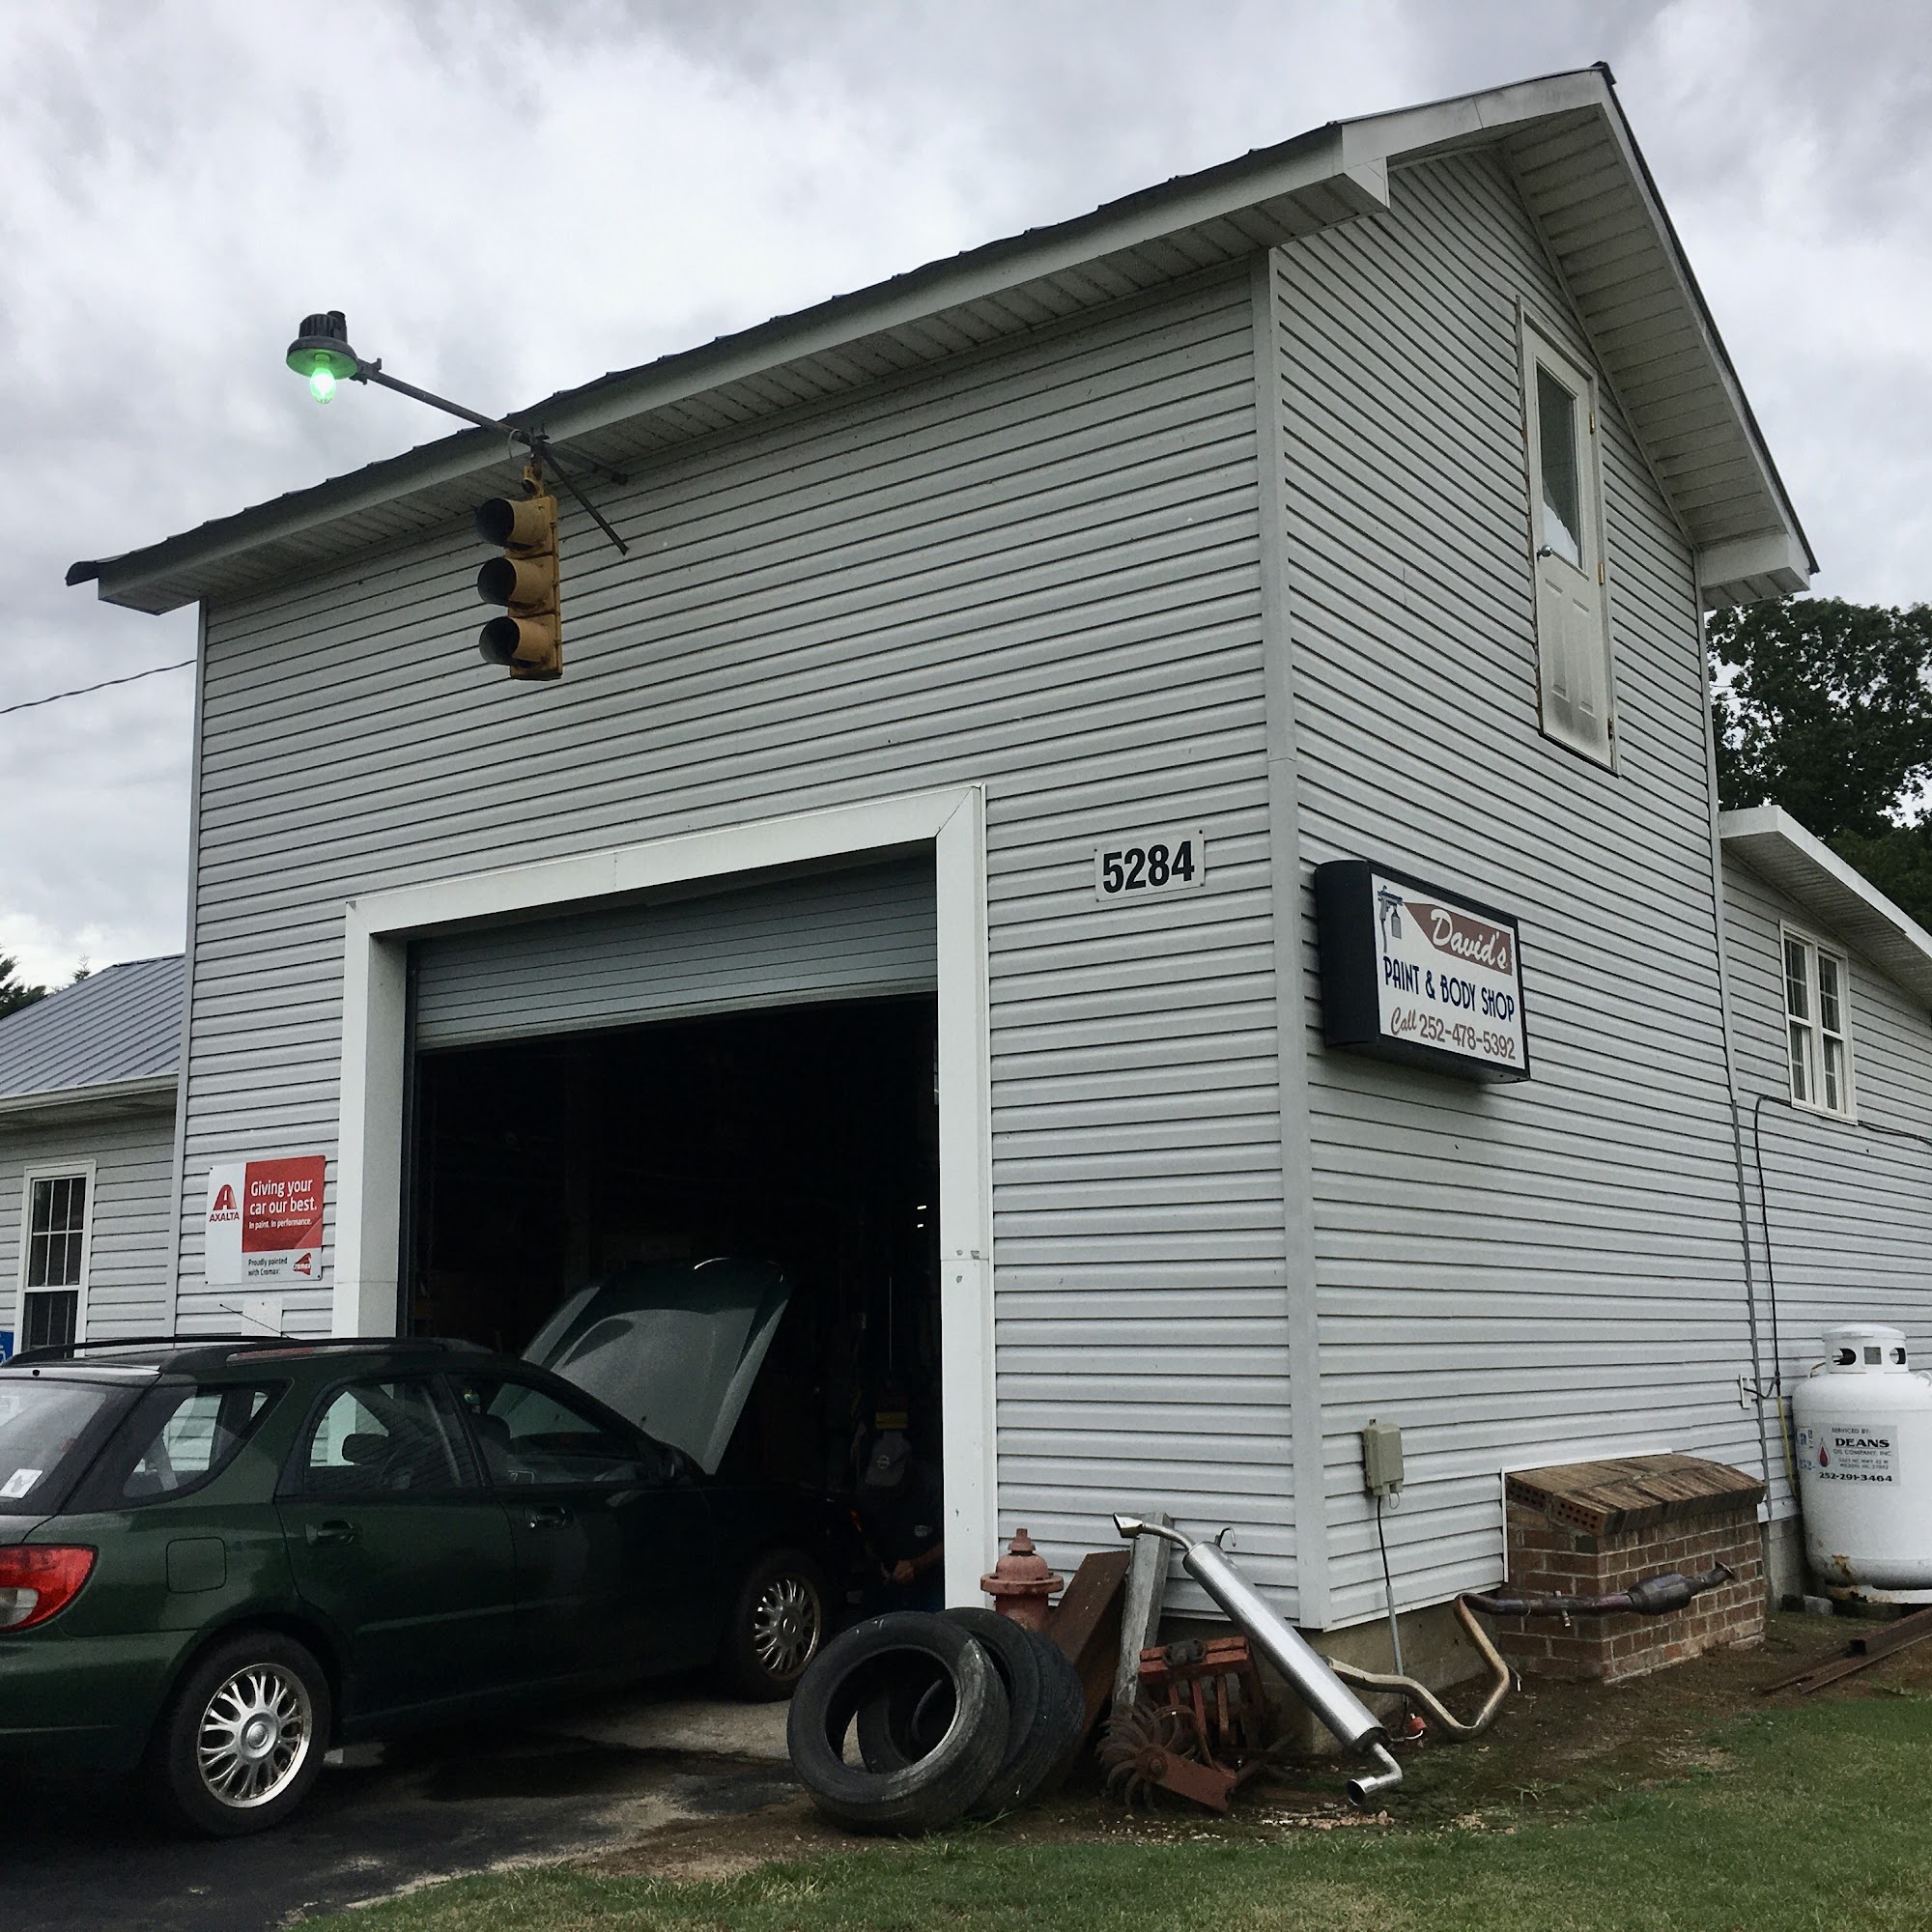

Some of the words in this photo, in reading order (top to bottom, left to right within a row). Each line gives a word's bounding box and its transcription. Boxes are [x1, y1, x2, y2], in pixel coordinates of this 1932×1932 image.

[1102, 839, 1195, 894] 5284
[1430, 908, 1509, 970] David's
[1383, 955, 1419, 995] PAINT
[1425, 970, 1435, 1000] &
[1440, 974, 1476, 1011] BODY
[1481, 986, 1515, 1022] SHOP
[1390, 1007, 1417, 1036] Call
[1419, 1013, 1516, 1061] 252-478-5392
[251, 1181, 285, 1197] Giving
[287, 1179, 313, 1197] your
[249, 1202, 268, 1215] car
[269, 1201, 287, 1214] our
[290, 1196, 317, 1212] best.
[209, 1212, 240, 1222] AXALTA
[270, 1219, 277, 1228] In
[248, 1258, 267, 1267] Proudly
[268, 1257, 288, 1266] painted
[1835, 1437, 1889, 1447] DEANS
[1819, 1472, 1892, 1482] 252-291-3464
